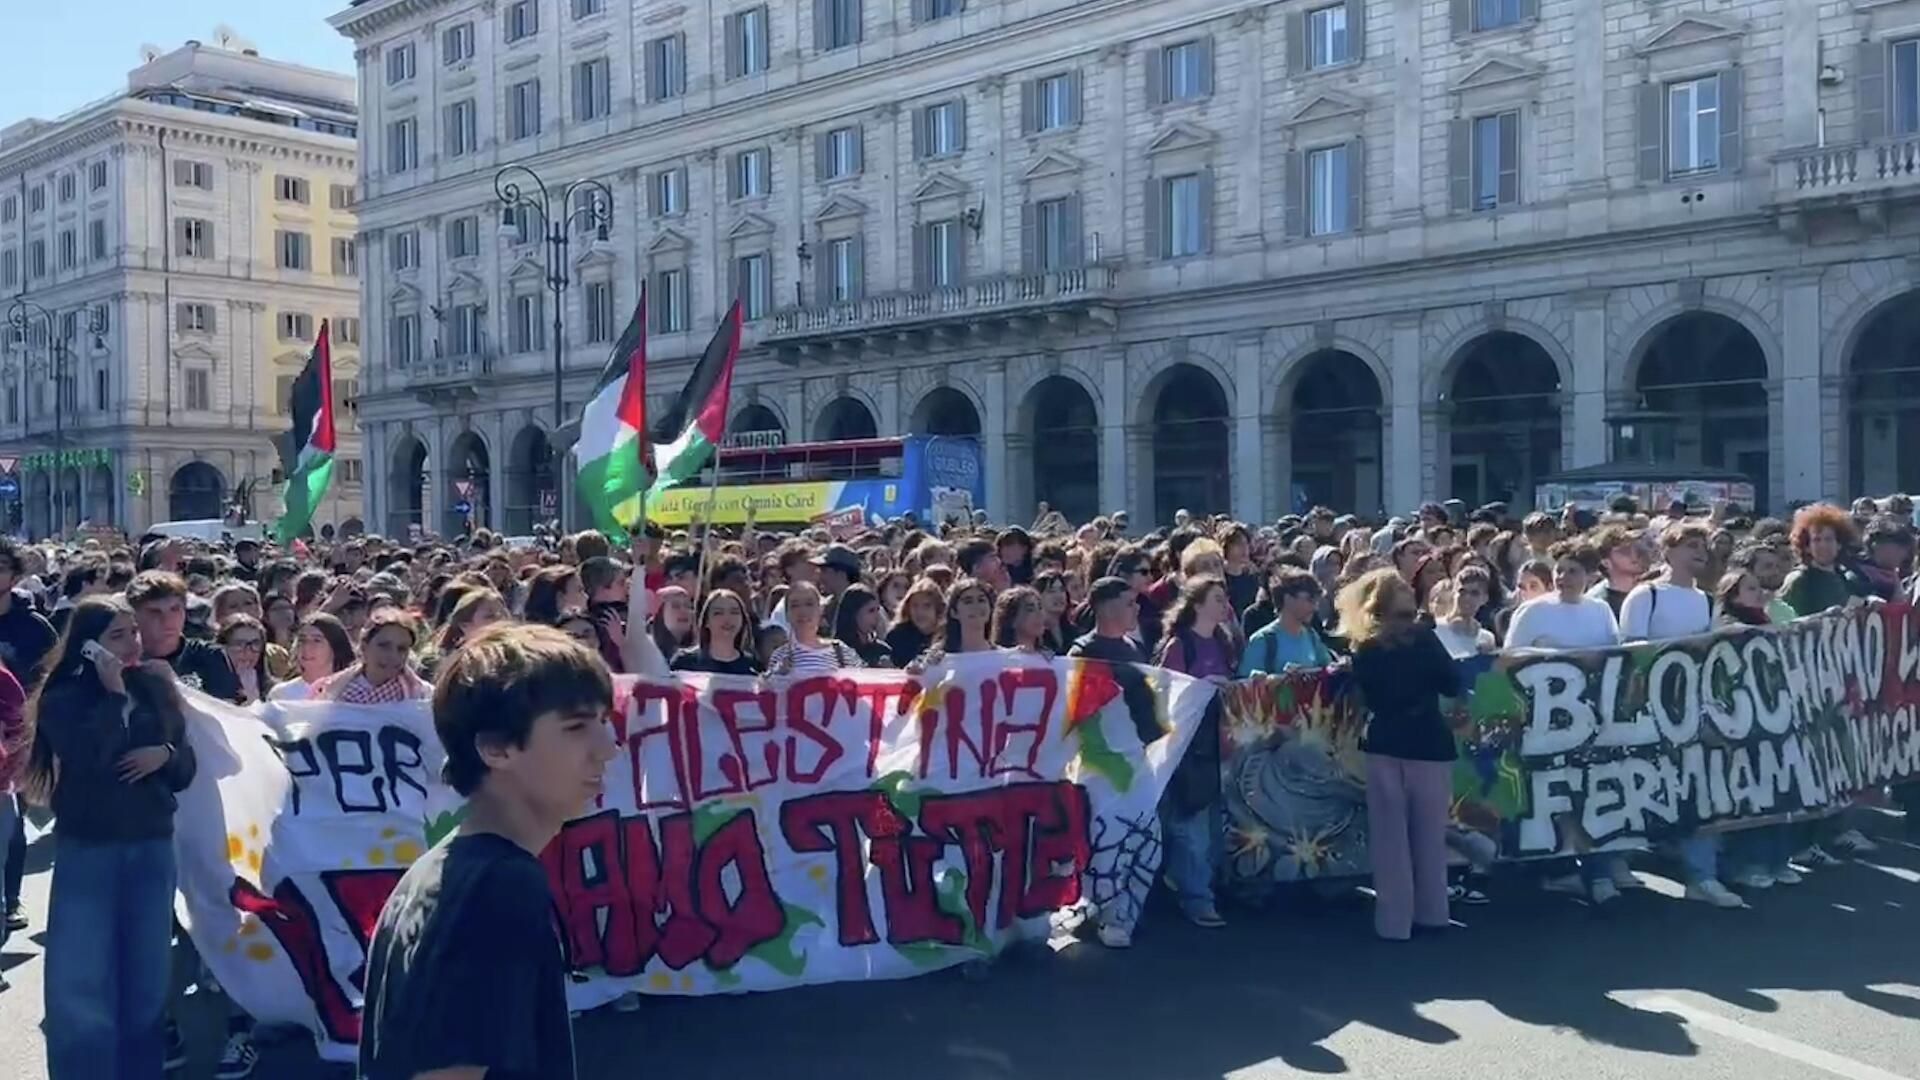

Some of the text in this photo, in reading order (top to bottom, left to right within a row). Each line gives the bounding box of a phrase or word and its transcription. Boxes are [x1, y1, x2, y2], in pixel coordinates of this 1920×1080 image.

[741, 493, 782, 511] Omnia
[785, 492, 815, 508] Card
[262, 667, 1059, 815] PER ALESTINA
[1516, 611, 1884, 755] BLOCCHIAMO
